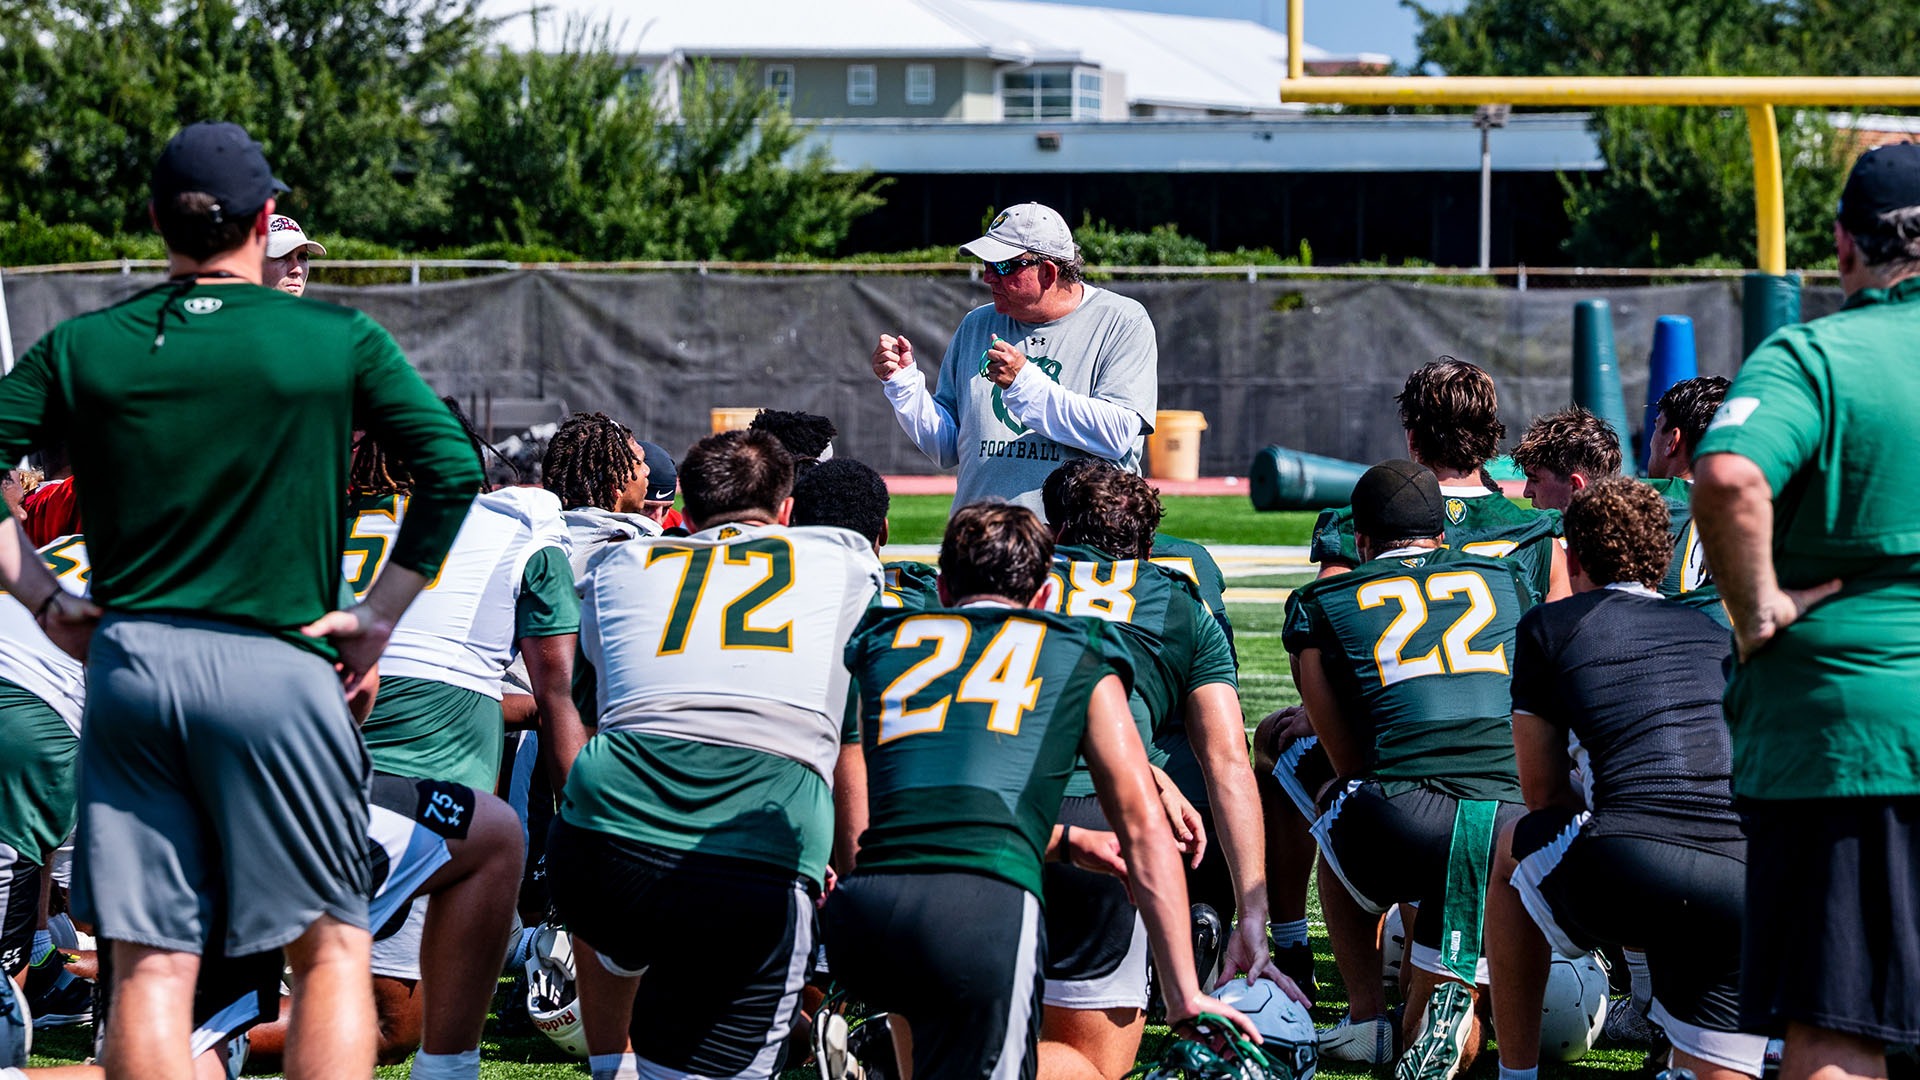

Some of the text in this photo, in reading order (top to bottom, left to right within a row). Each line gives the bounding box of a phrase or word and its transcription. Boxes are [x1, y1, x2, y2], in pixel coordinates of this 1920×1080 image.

[979, 440, 1060, 462] FOOTBALL
[645, 536, 795, 657] 72
[1356, 570, 1510, 687] 22
[877, 614, 1047, 744] 24
[424, 791, 453, 823] 75
